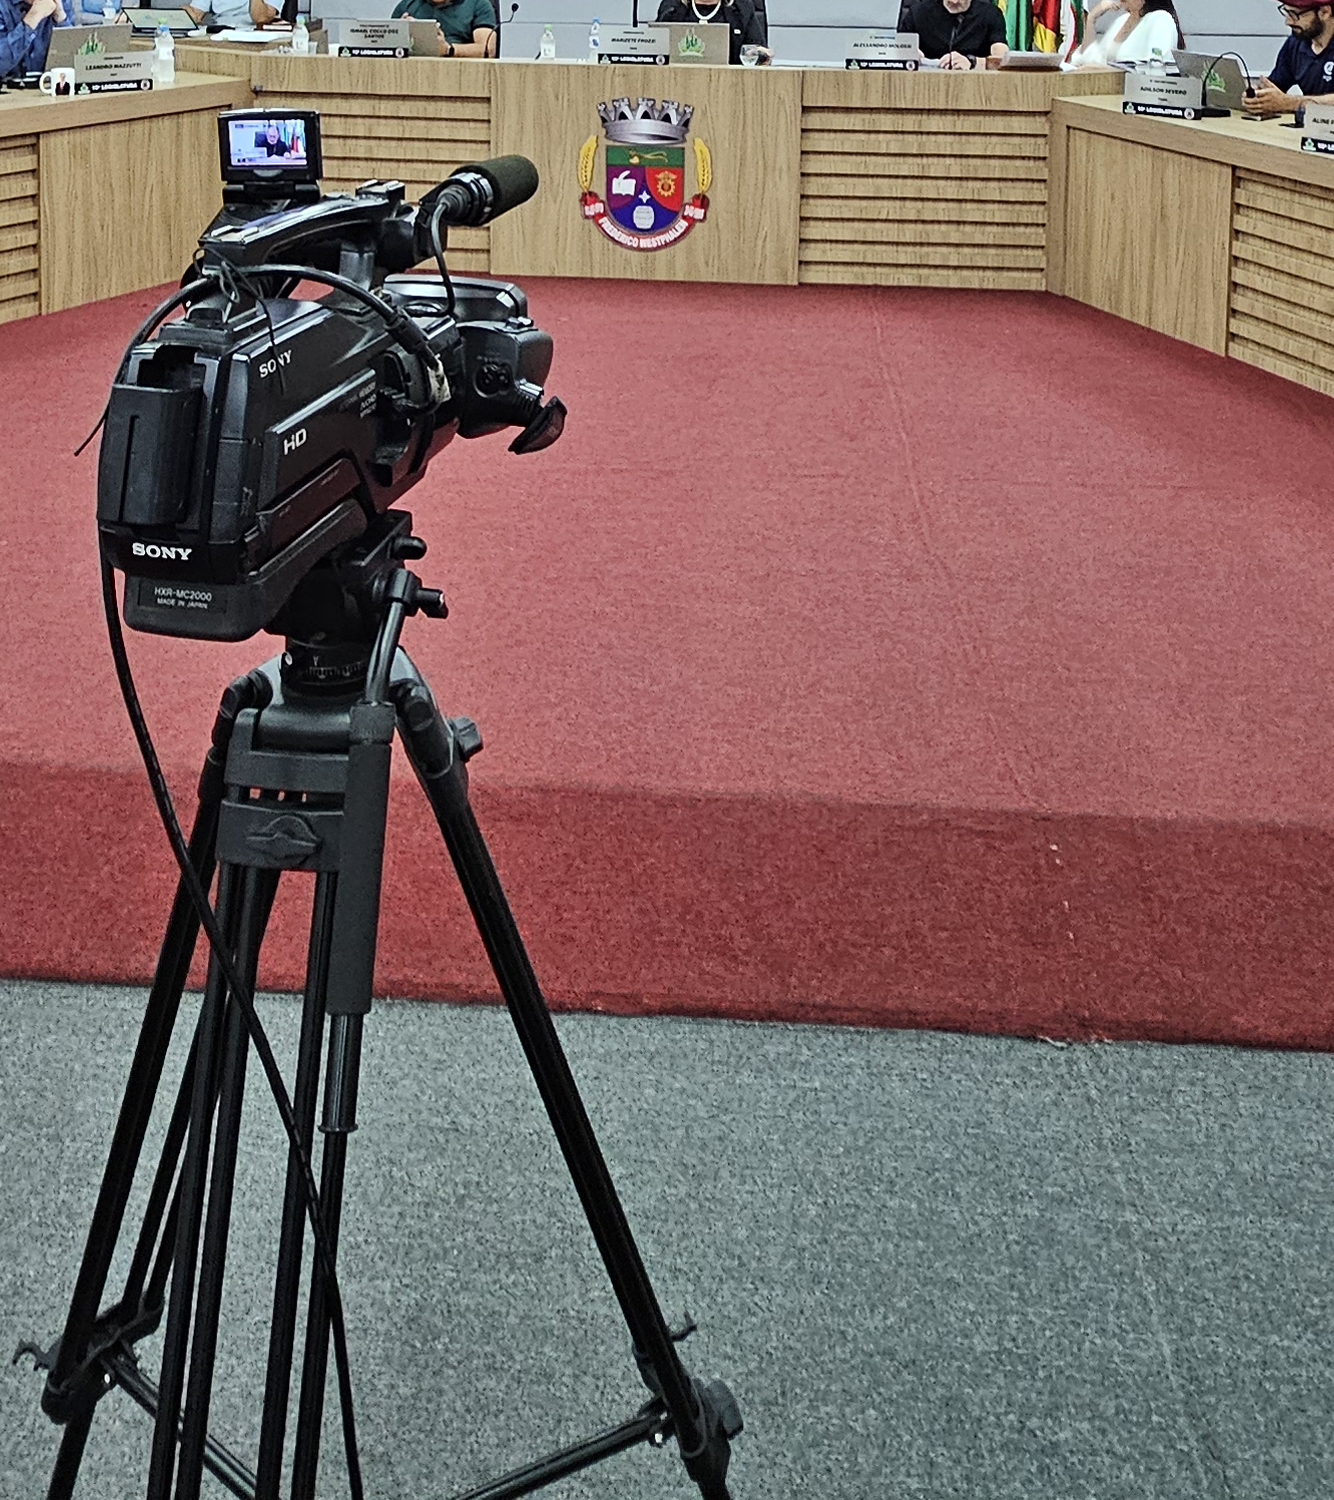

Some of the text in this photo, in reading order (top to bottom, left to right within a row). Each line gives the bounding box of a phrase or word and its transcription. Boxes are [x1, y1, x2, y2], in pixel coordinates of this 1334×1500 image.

[1312, 117, 1330, 125] ALINE
[258, 349, 292, 378] SONY
[283, 428, 307, 456] HD
[132, 542, 193, 561] SONY
[154, 586, 212, 602] HXR-MC2000
[157, 597, 208, 609] MADE IN JAPAN
